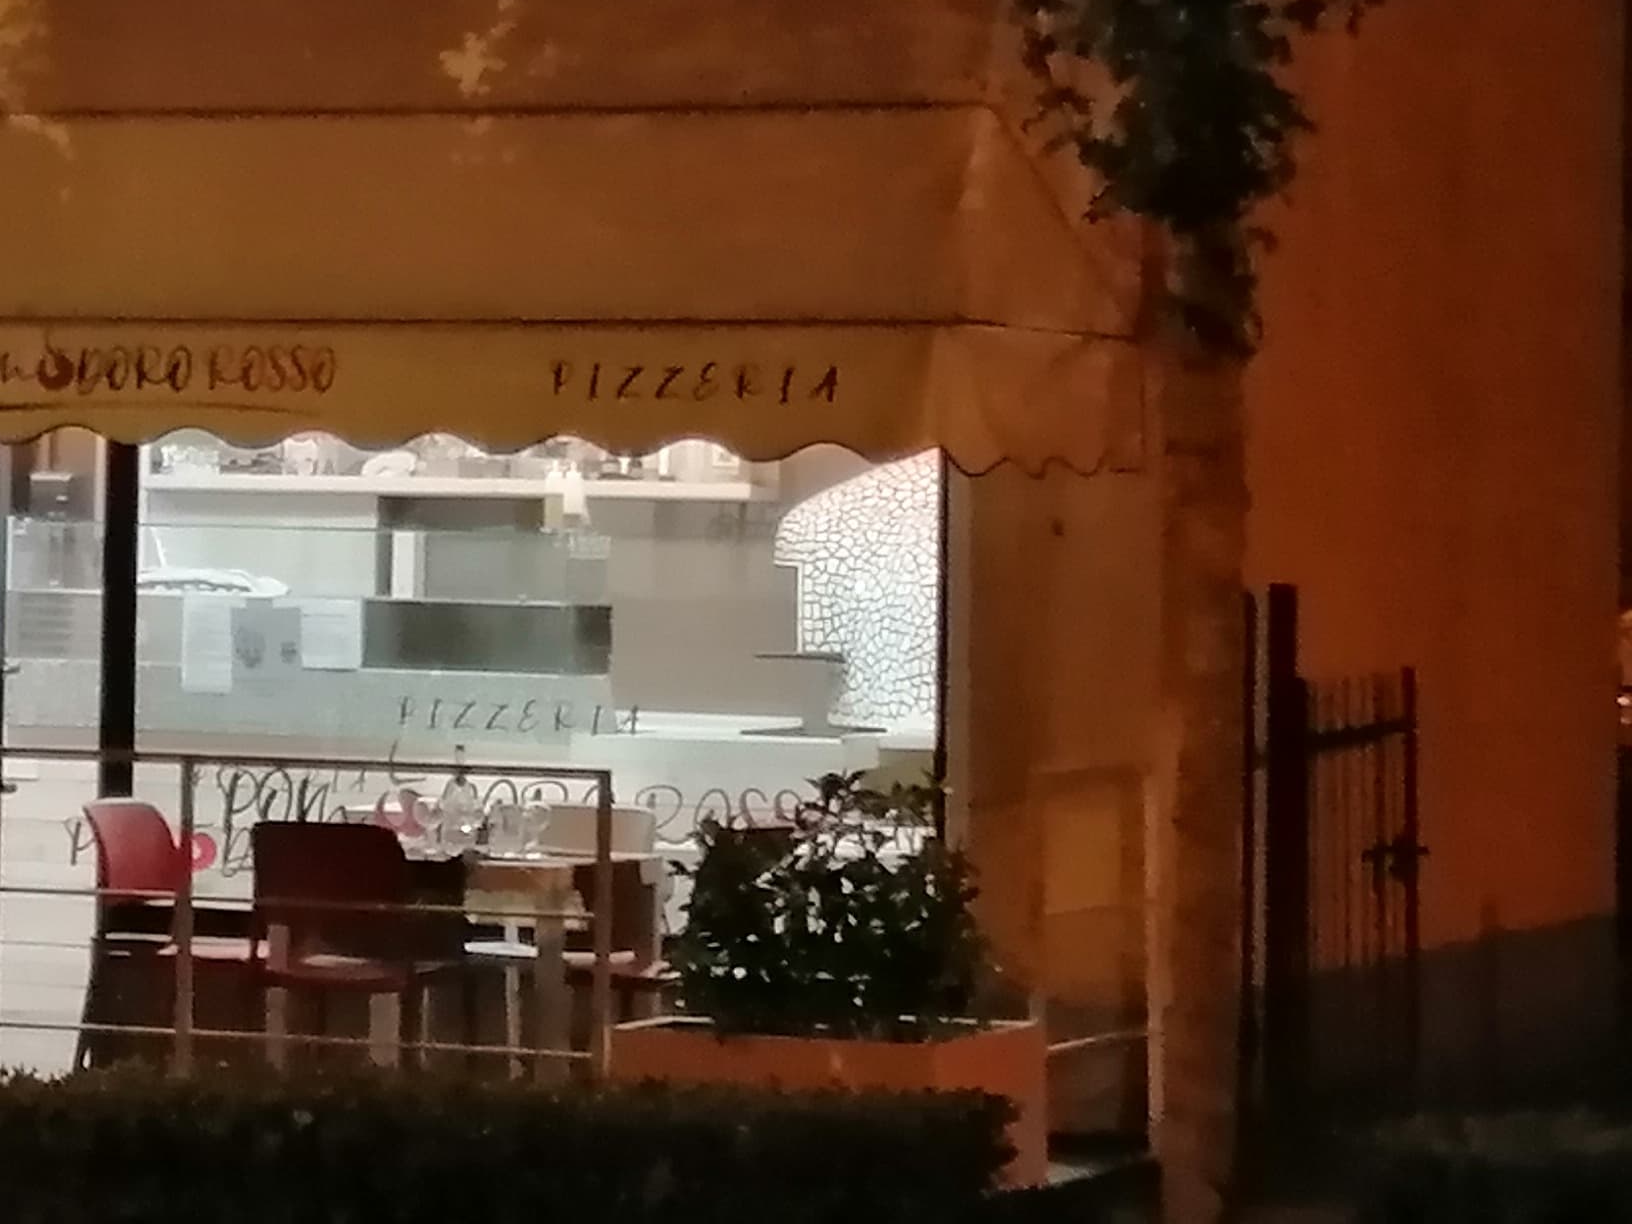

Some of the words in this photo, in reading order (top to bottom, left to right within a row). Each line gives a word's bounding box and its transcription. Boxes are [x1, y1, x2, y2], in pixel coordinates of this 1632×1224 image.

[208, 343, 337, 394] ROSSO
[552, 359, 838, 404] PIZZERIA
[398, 695, 641, 737] PIZZERIA
